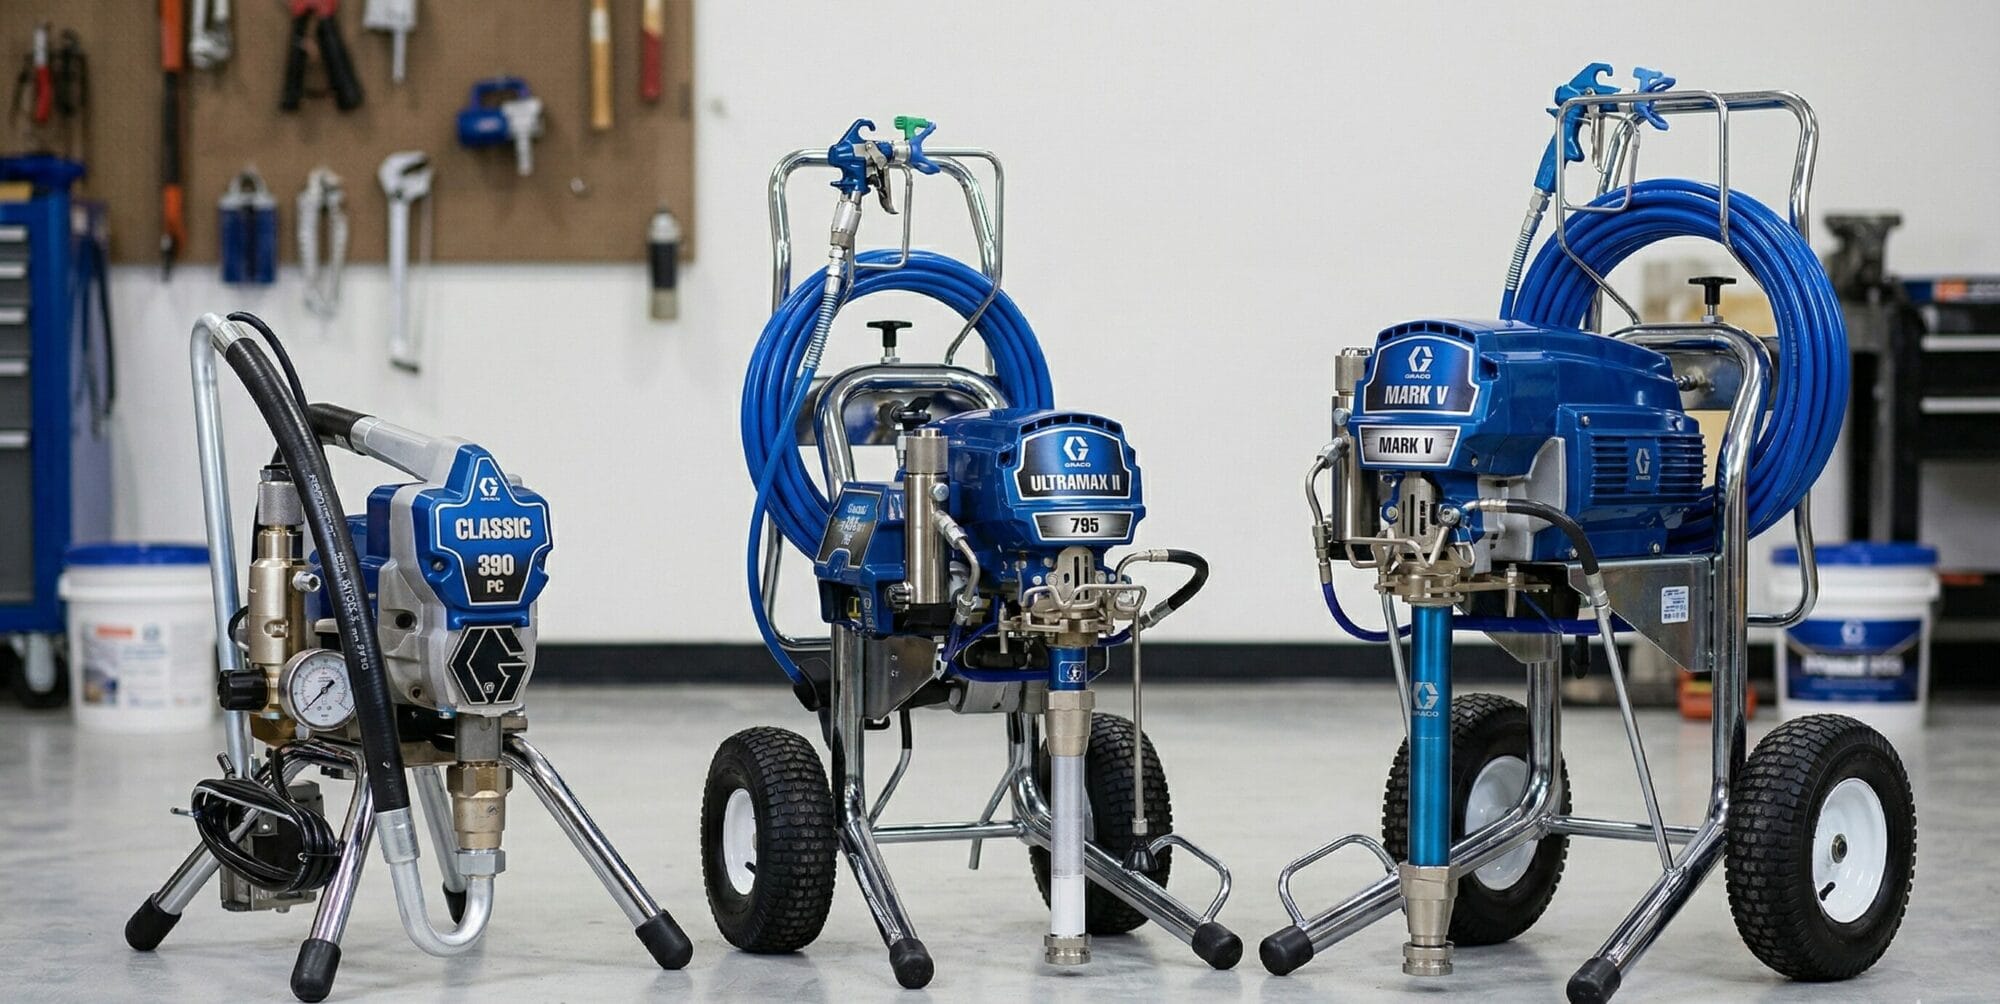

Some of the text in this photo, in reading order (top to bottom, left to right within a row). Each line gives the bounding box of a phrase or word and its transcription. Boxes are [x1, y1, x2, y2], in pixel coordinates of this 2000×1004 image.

[1384, 385, 1449, 405] MARK V
[1379, 437, 1434, 454] MARK V
[1030, 474, 1121, 491] ULTRAMAX II
[455, 517, 532, 540] CLASSIC
[1070, 518, 1099, 533] 795
[478, 554, 514, 576] 390
[486, 580, 504, 593] PC
